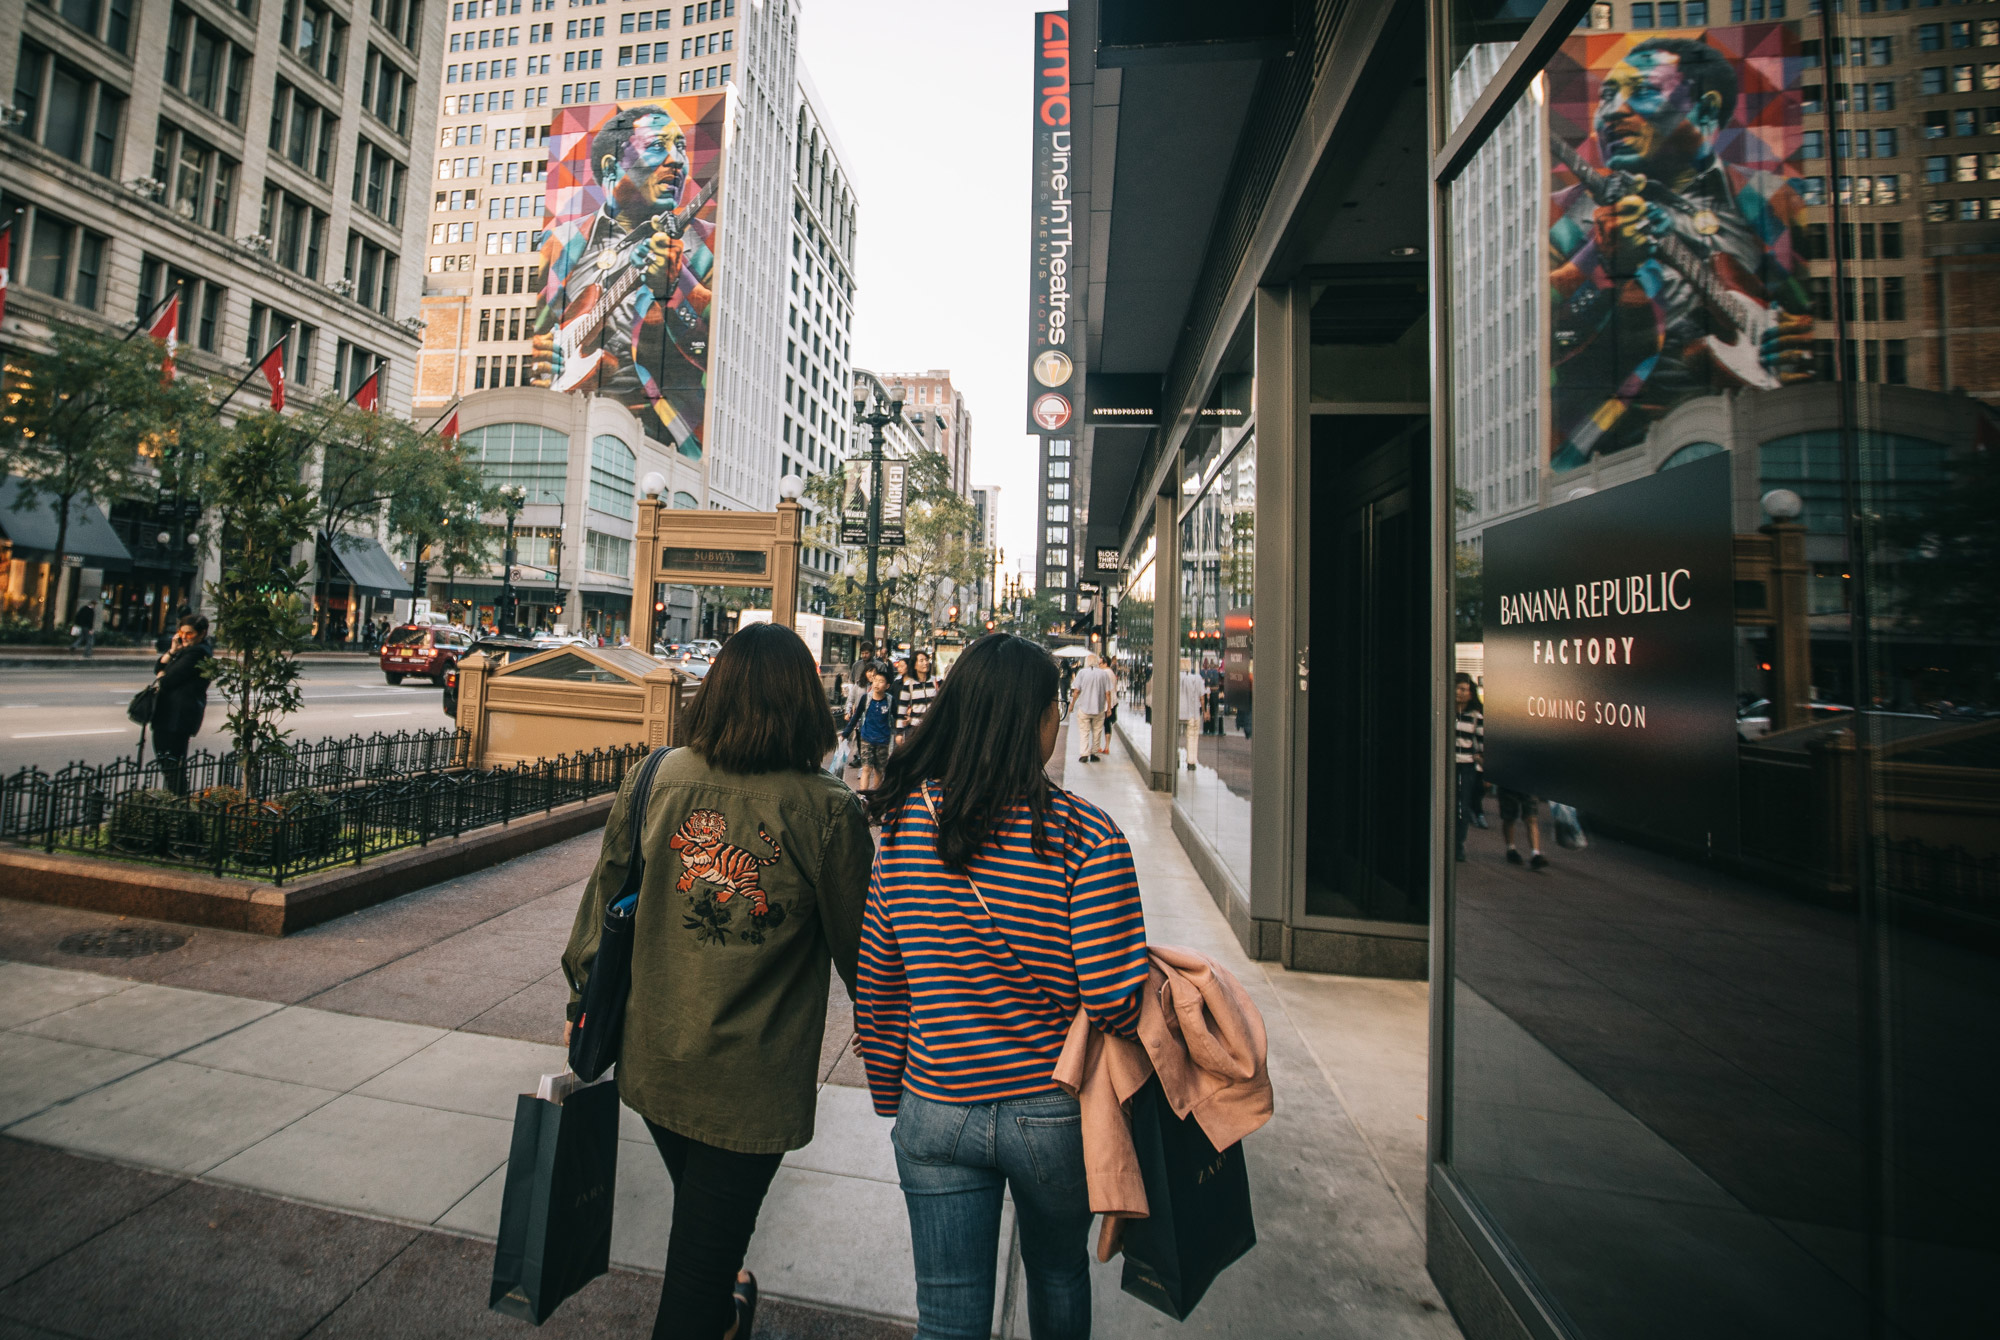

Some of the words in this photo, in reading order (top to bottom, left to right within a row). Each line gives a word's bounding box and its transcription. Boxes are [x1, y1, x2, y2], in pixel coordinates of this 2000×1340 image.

[1092, 408, 1154, 416] ANTHROPOLOGIE
[694, 551, 736, 561] SUBWAY
[1098, 550, 1119, 558] BLOCK
[1500, 588, 1570, 625] BANANA
[1576, 569, 1691, 618] REPUBLIC
[1533, 636, 1634, 666] FACTORY
[1527, 696, 1587, 723] COMING
[1594, 701, 1647, 729] SOON
